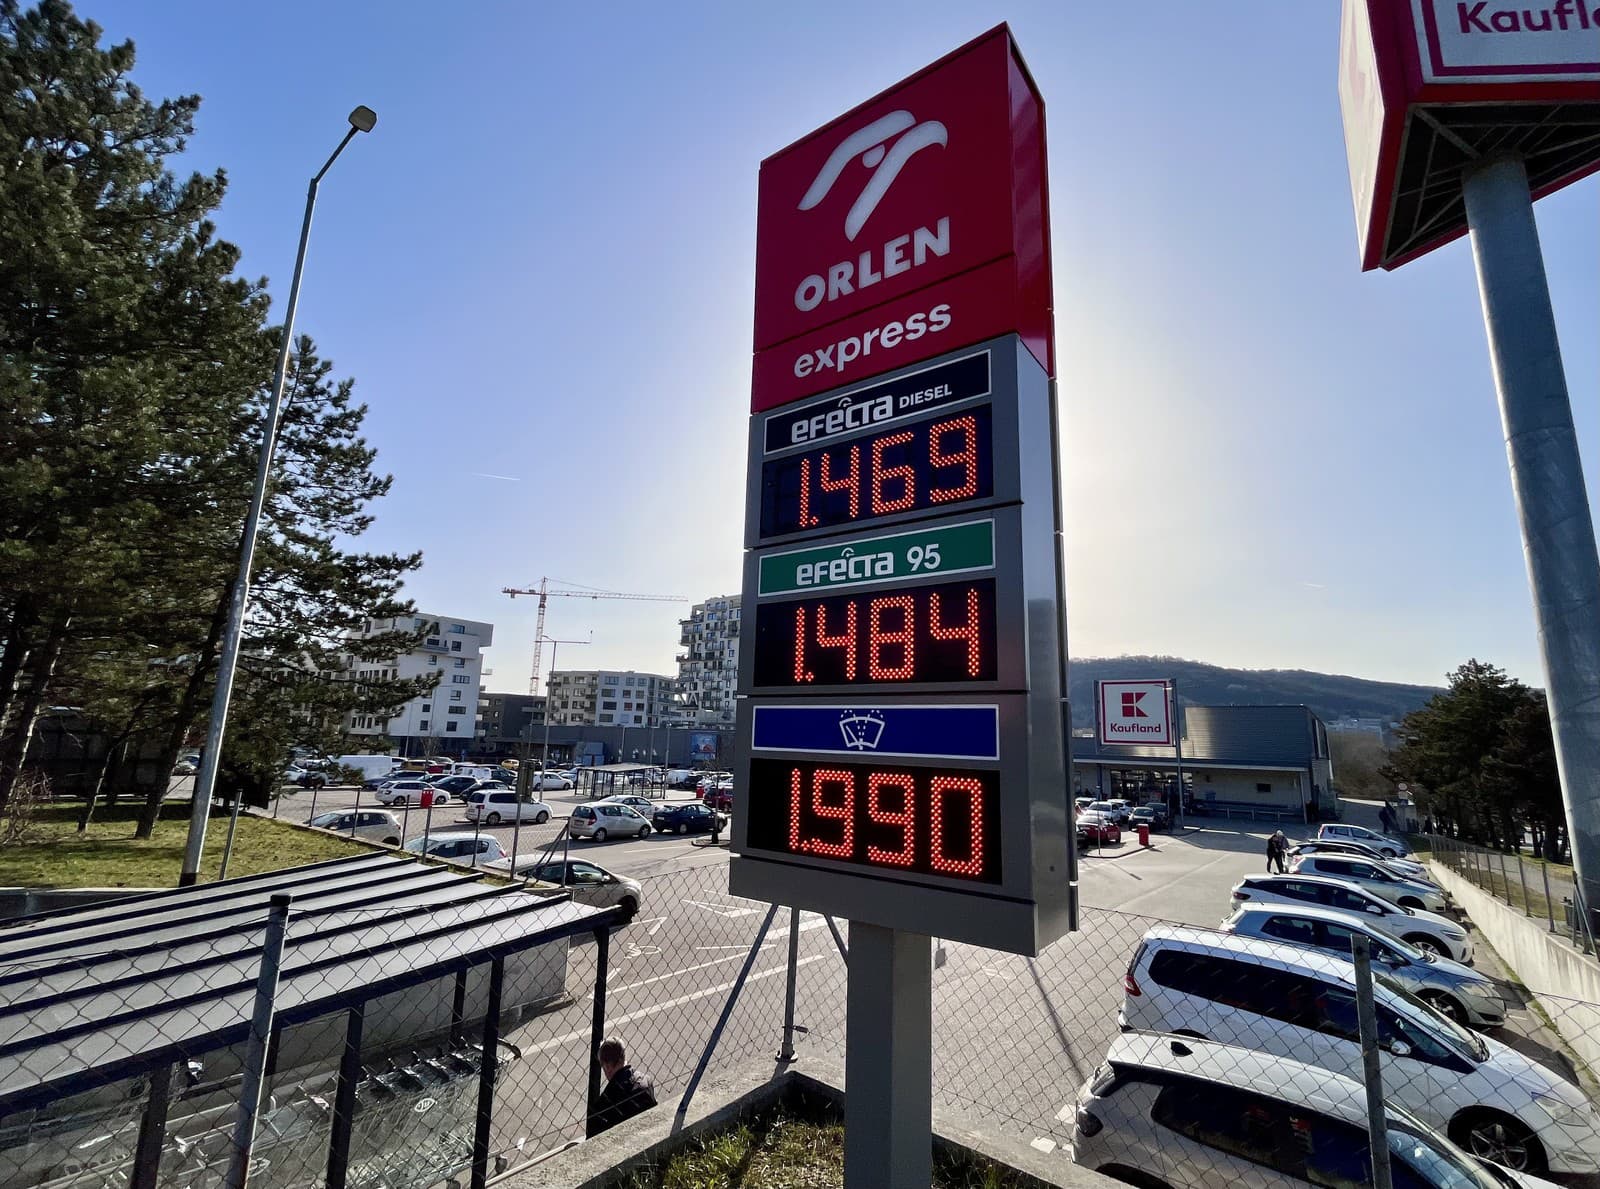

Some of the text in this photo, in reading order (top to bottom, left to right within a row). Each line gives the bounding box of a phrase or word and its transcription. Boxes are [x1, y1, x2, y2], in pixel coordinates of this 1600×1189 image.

[1456, 0, 1600, 34] Kaufl
[794, 216, 951, 312] ORLEN
[794, 303, 951, 378] express
[899, 384, 952, 409] DIESEL
[799, 415, 977, 528] 1.469
[906, 543, 941, 572] 95
[794, 588, 981, 682] 1.484
[1110, 722, 1162, 733] Kaufland
[788, 767, 983, 876] 1.990
